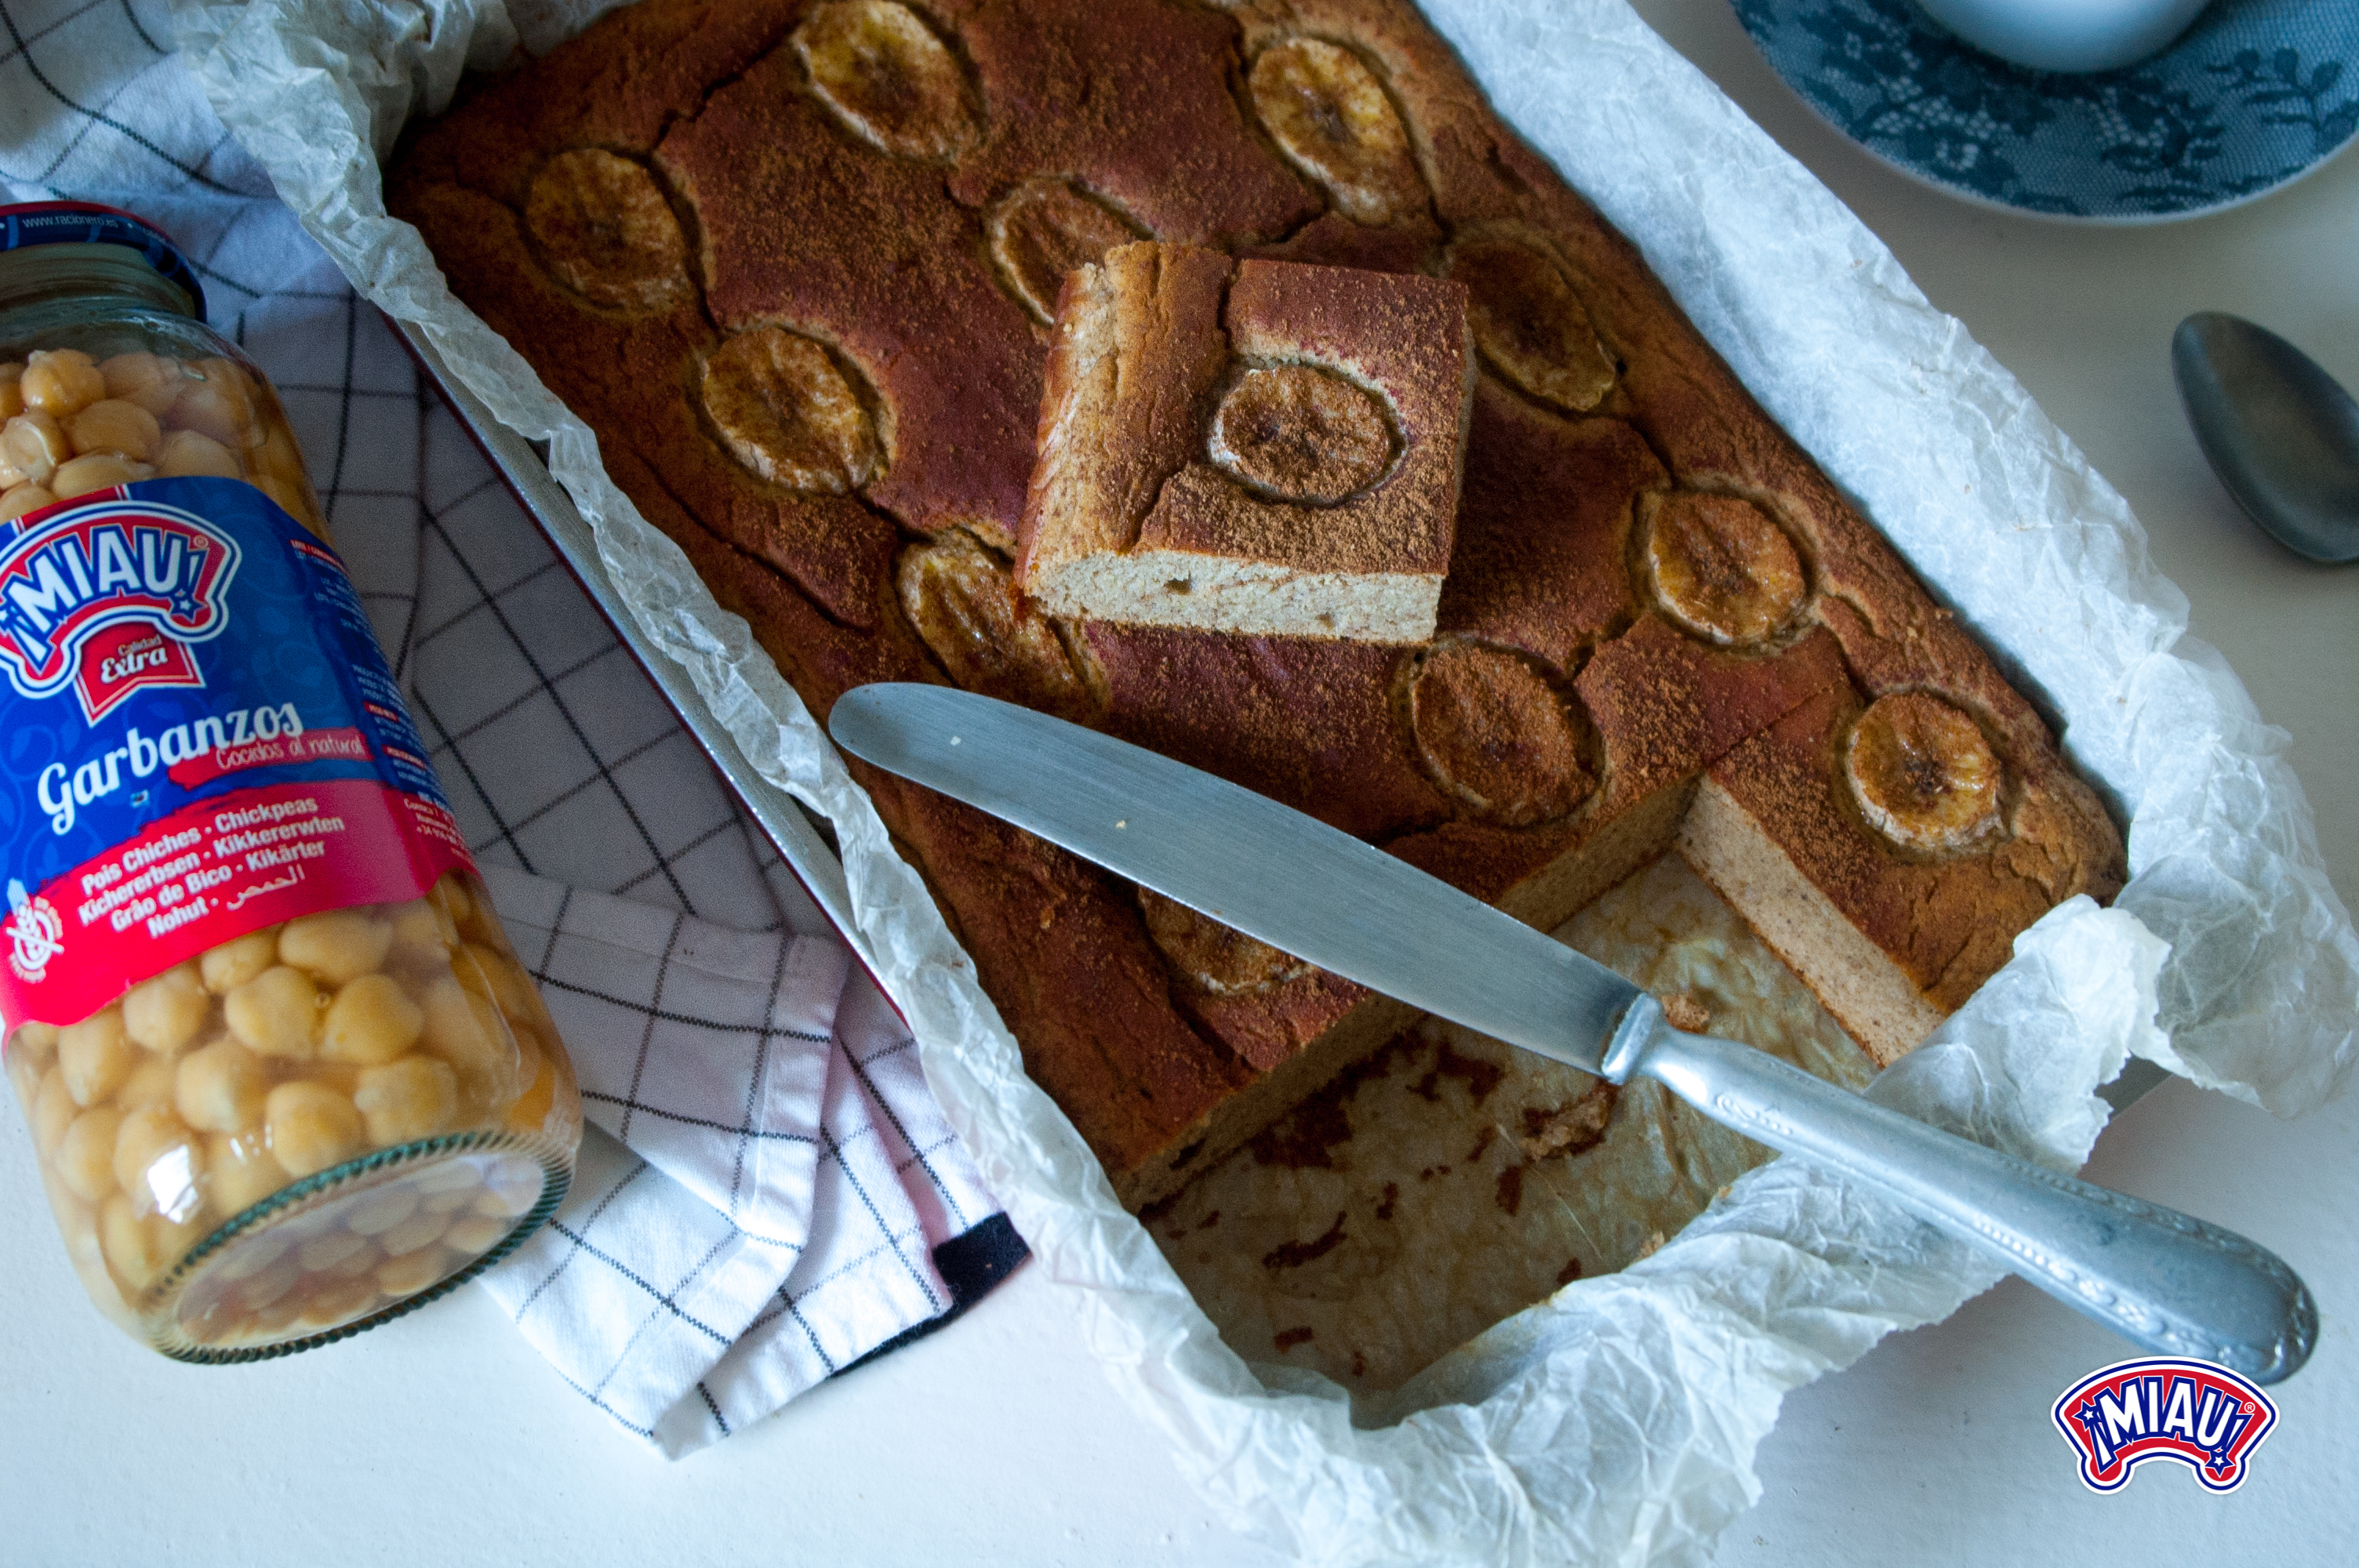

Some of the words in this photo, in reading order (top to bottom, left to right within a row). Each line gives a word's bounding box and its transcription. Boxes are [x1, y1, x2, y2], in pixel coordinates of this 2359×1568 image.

[22, 213, 119, 228] www.racionero.es
[100, 647, 168, 684] Extra
[118, 634, 162, 656] Calidad
[37, 702, 304, 836] Garbanzos
[216, 742, 285, 770] Cocidos
[288, 735, 306, 757] al
[309, 733, 365, 755] natural
[81, 862, 122, 898] Pois
[122, 827, 202, 873] Chiches
[214, 797, 318, 833] Chickpeas
[77, 851, 202, 927] Kichererbsen
[213, 816, 345, 858] Kikkererwten
[158, 884, 185, 907] de
[184, 865, 233, 895] Bico
[245, 840, 325, 873] Kikärter
[146, 895, 209, 939] Nohut
